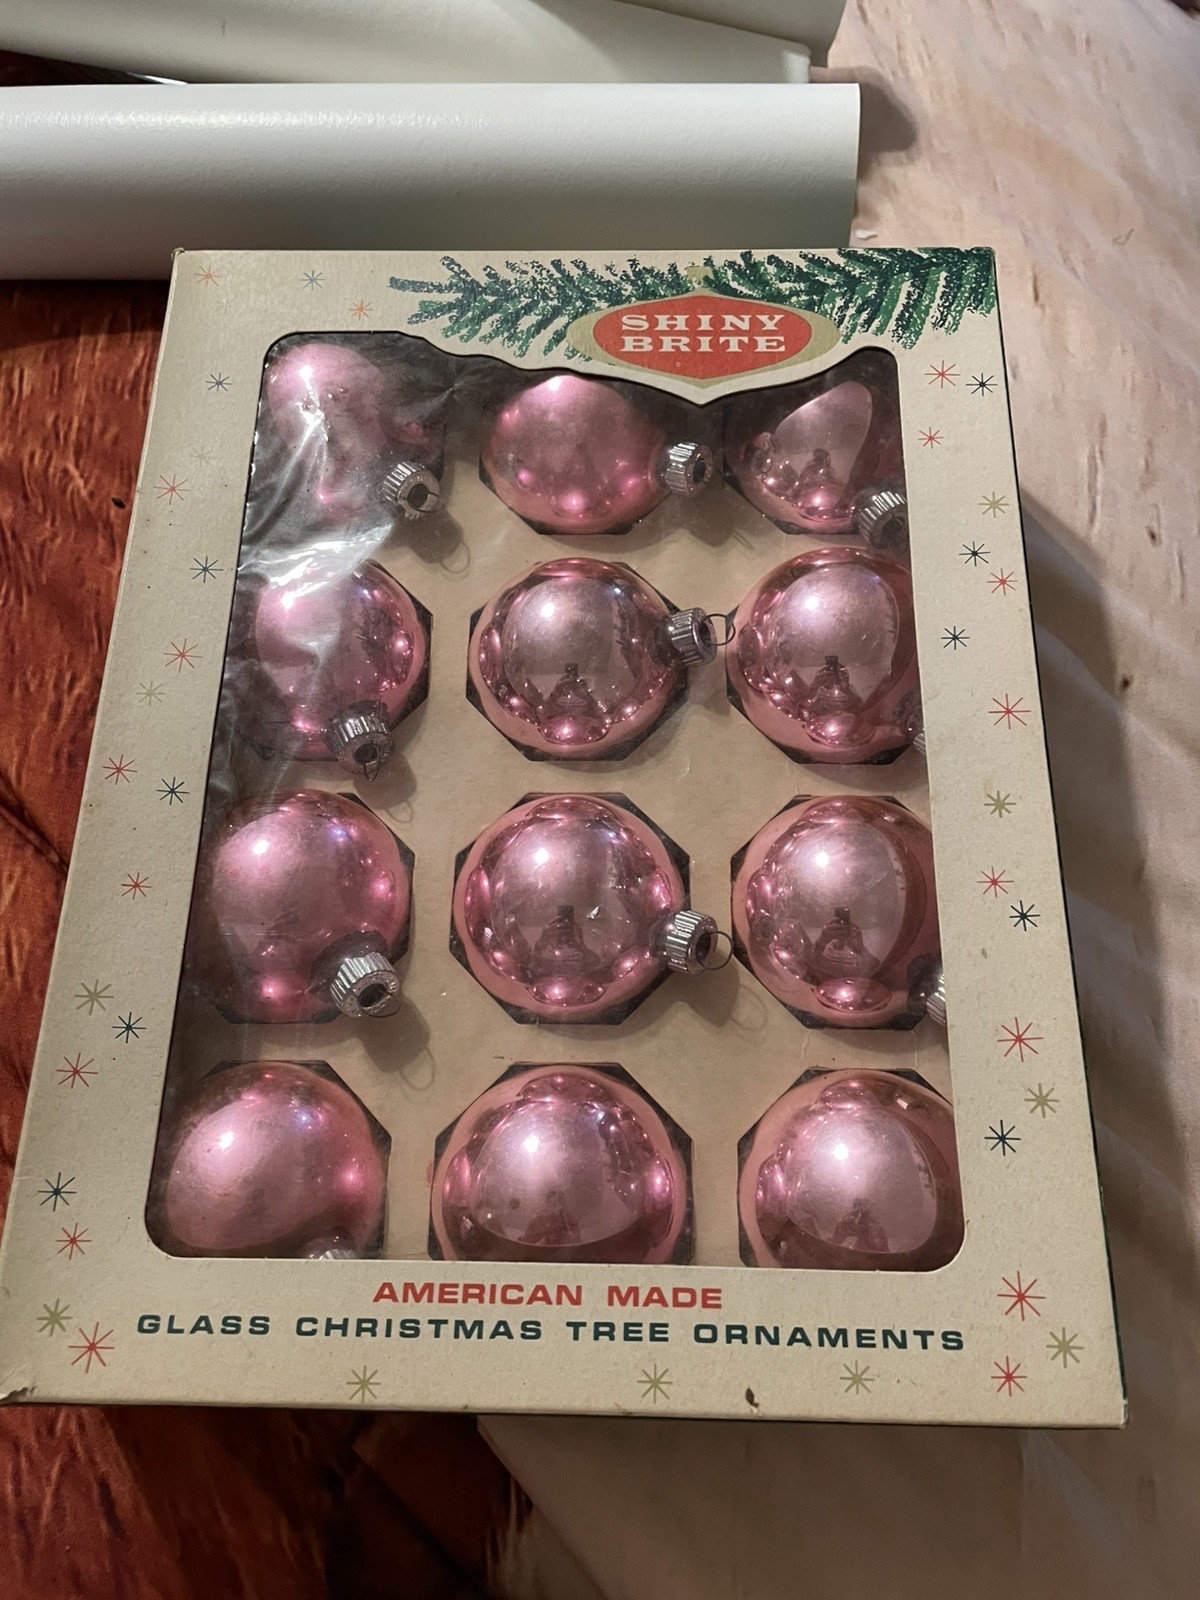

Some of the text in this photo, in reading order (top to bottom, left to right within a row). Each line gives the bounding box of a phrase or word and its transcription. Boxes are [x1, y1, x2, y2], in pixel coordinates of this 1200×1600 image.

[622, 315, 785, 330] SHINY
[620, 336, 786, 352] BRITE
[373, 1282, 723, 1309] AMERICAN MADE
[137, 1314, 964, 1351] GLASS CHRISTMAS TREE ORNAMENTS
